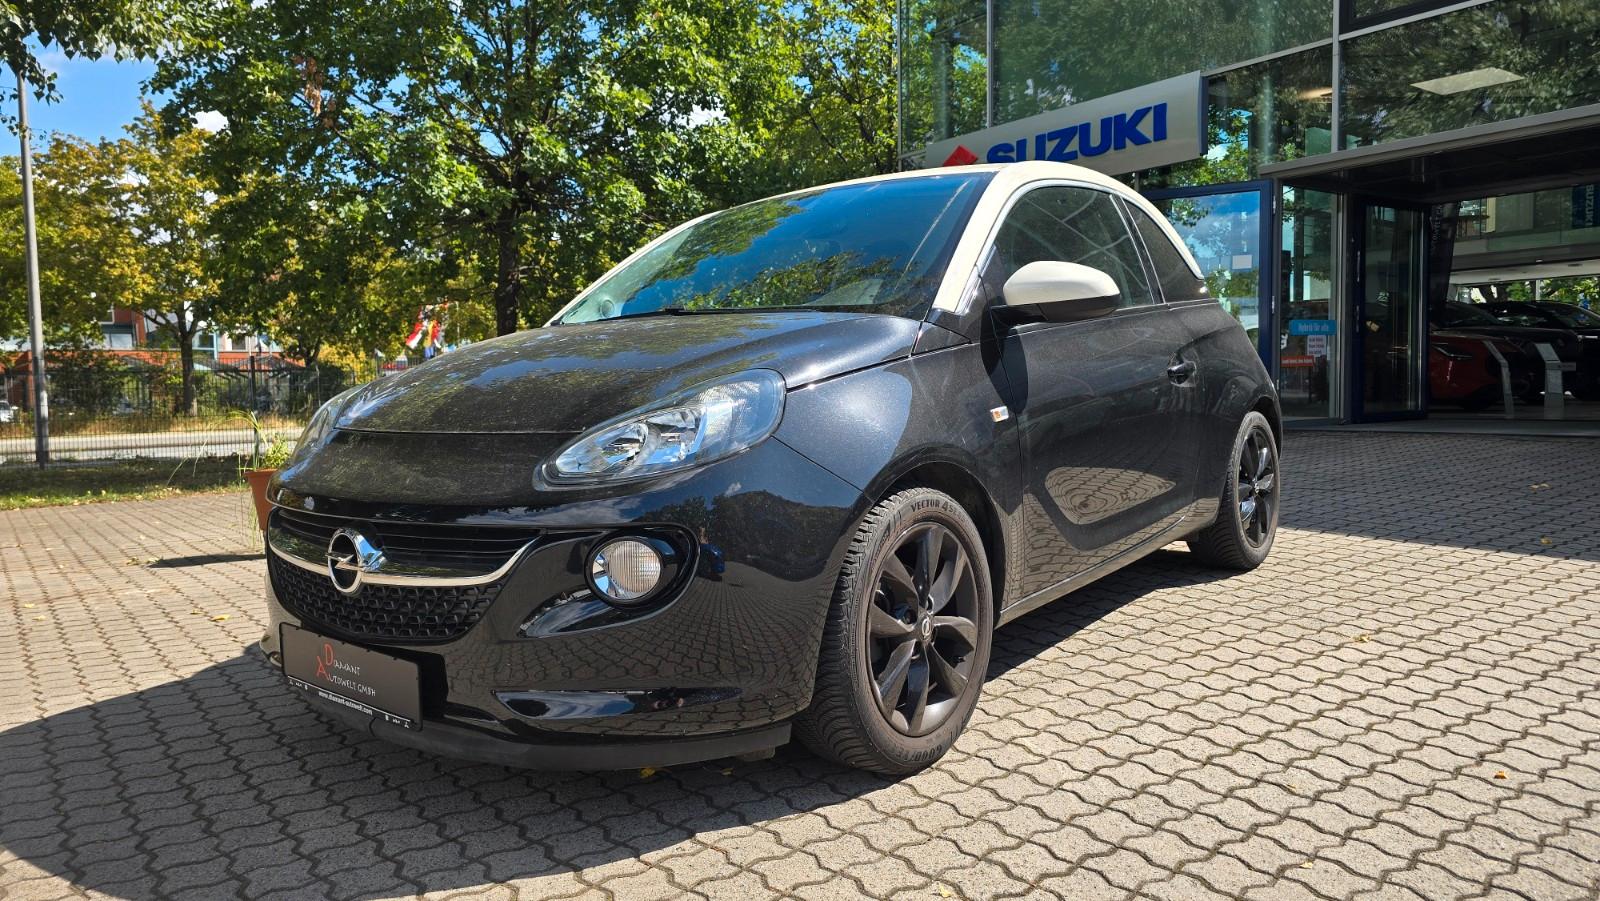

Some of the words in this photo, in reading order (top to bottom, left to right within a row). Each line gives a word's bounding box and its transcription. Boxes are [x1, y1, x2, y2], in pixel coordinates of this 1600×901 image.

[987, 102, 1167, 163] SUZUKI
[1585, 184, 1595, 226] SUZUKI
[911, 499, 940, 512] VECTOR
[318, 691, 373, 716] www.diamant-autowelt.com
